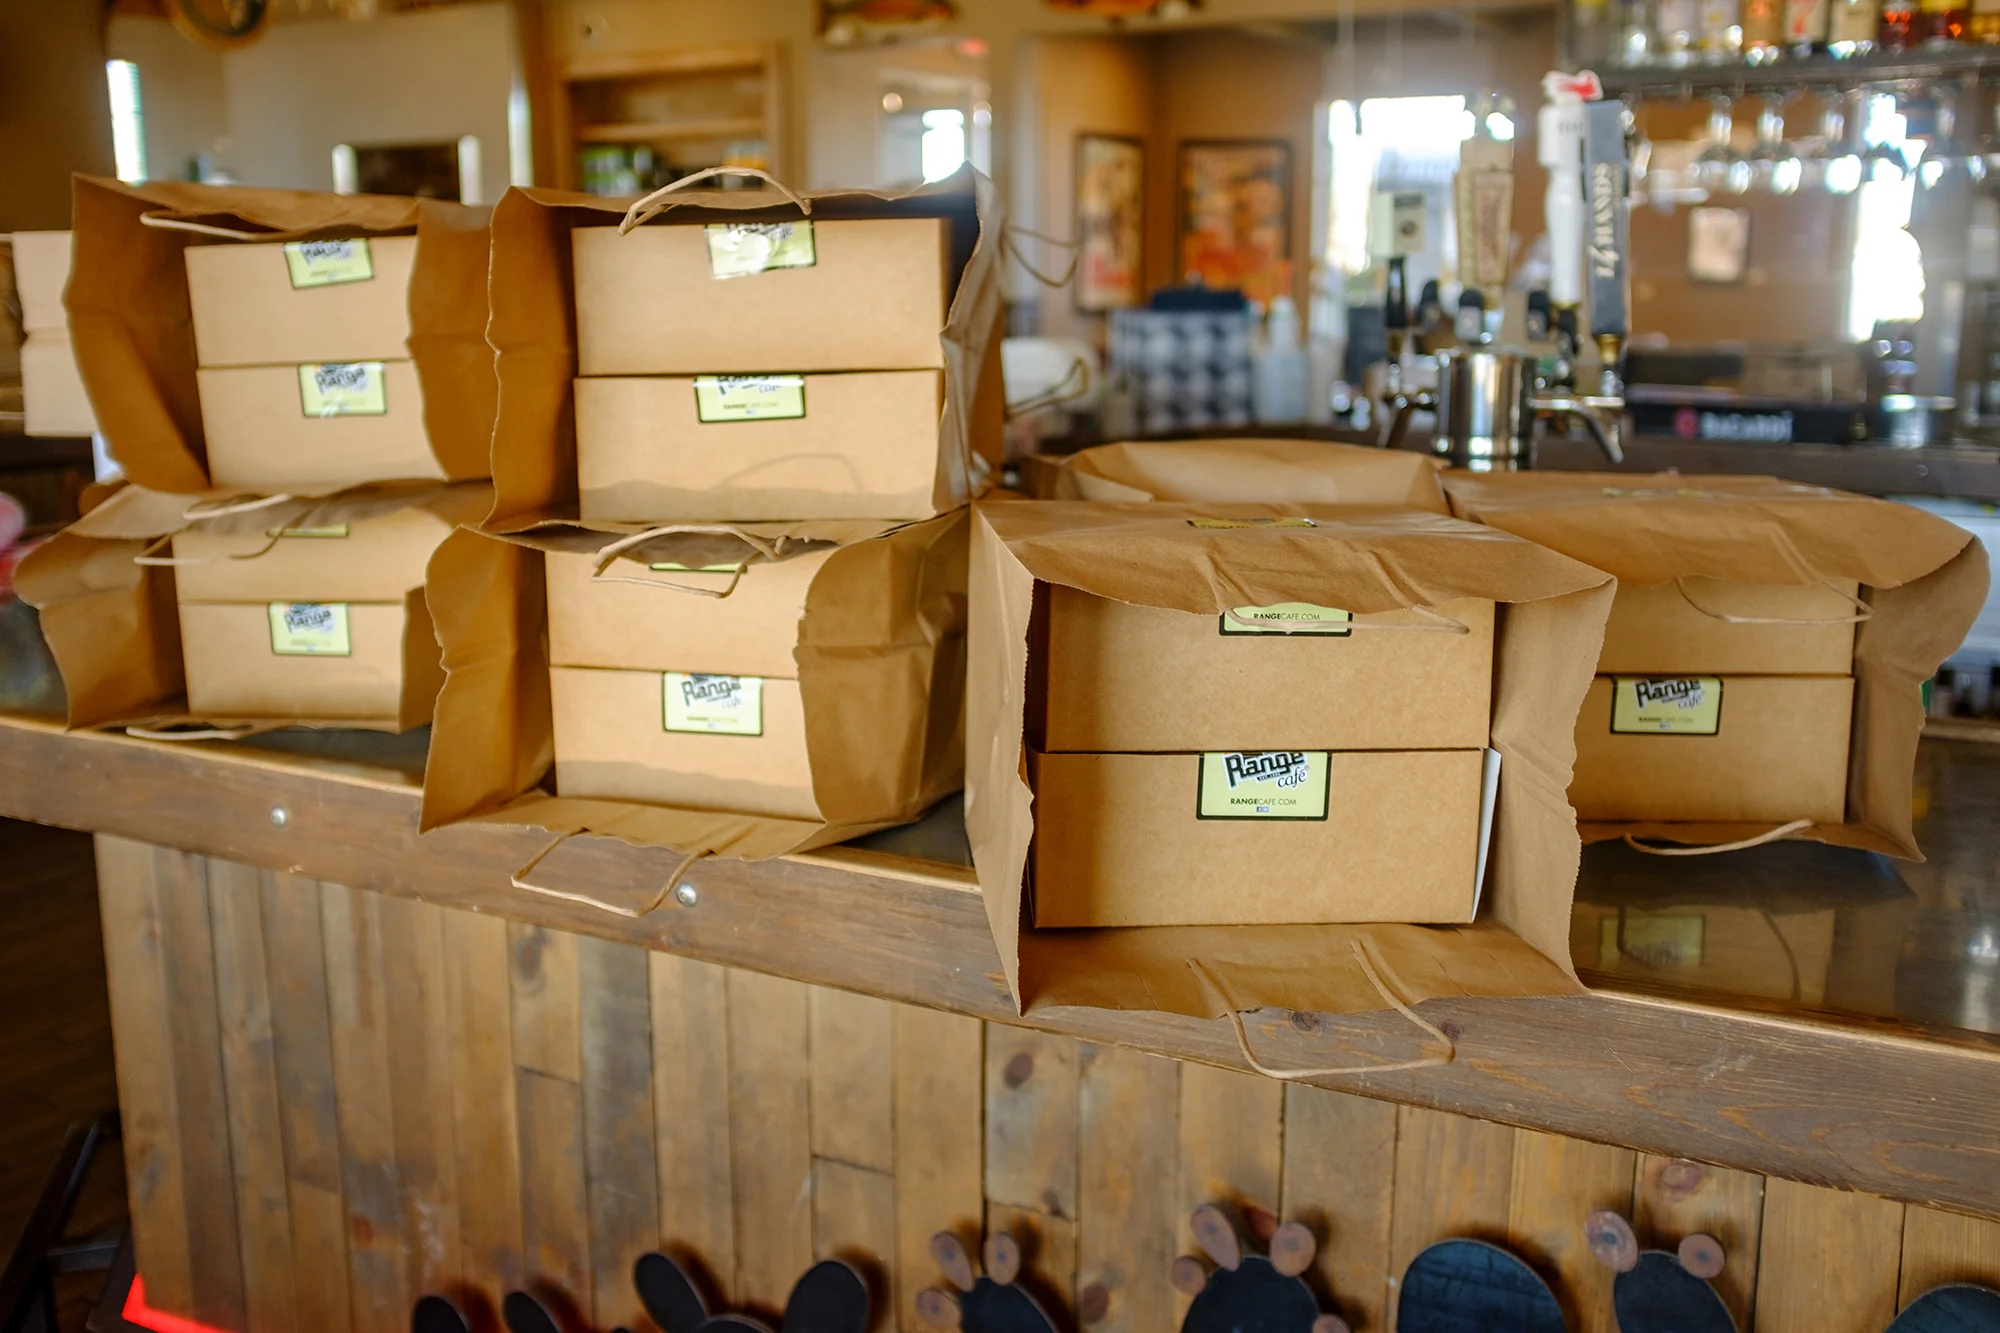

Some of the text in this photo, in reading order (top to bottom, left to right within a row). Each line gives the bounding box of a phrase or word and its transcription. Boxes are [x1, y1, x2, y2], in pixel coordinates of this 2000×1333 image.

[1253, 613, 1320, 621] RANGECAFE.COM
[681, 680, 742, 707] Range
[1635, 679, 1702, 708] Range
[1224, 752, 1305, 788] Range
[1230, 798, 1297, 806] RANGECAFE.COM
